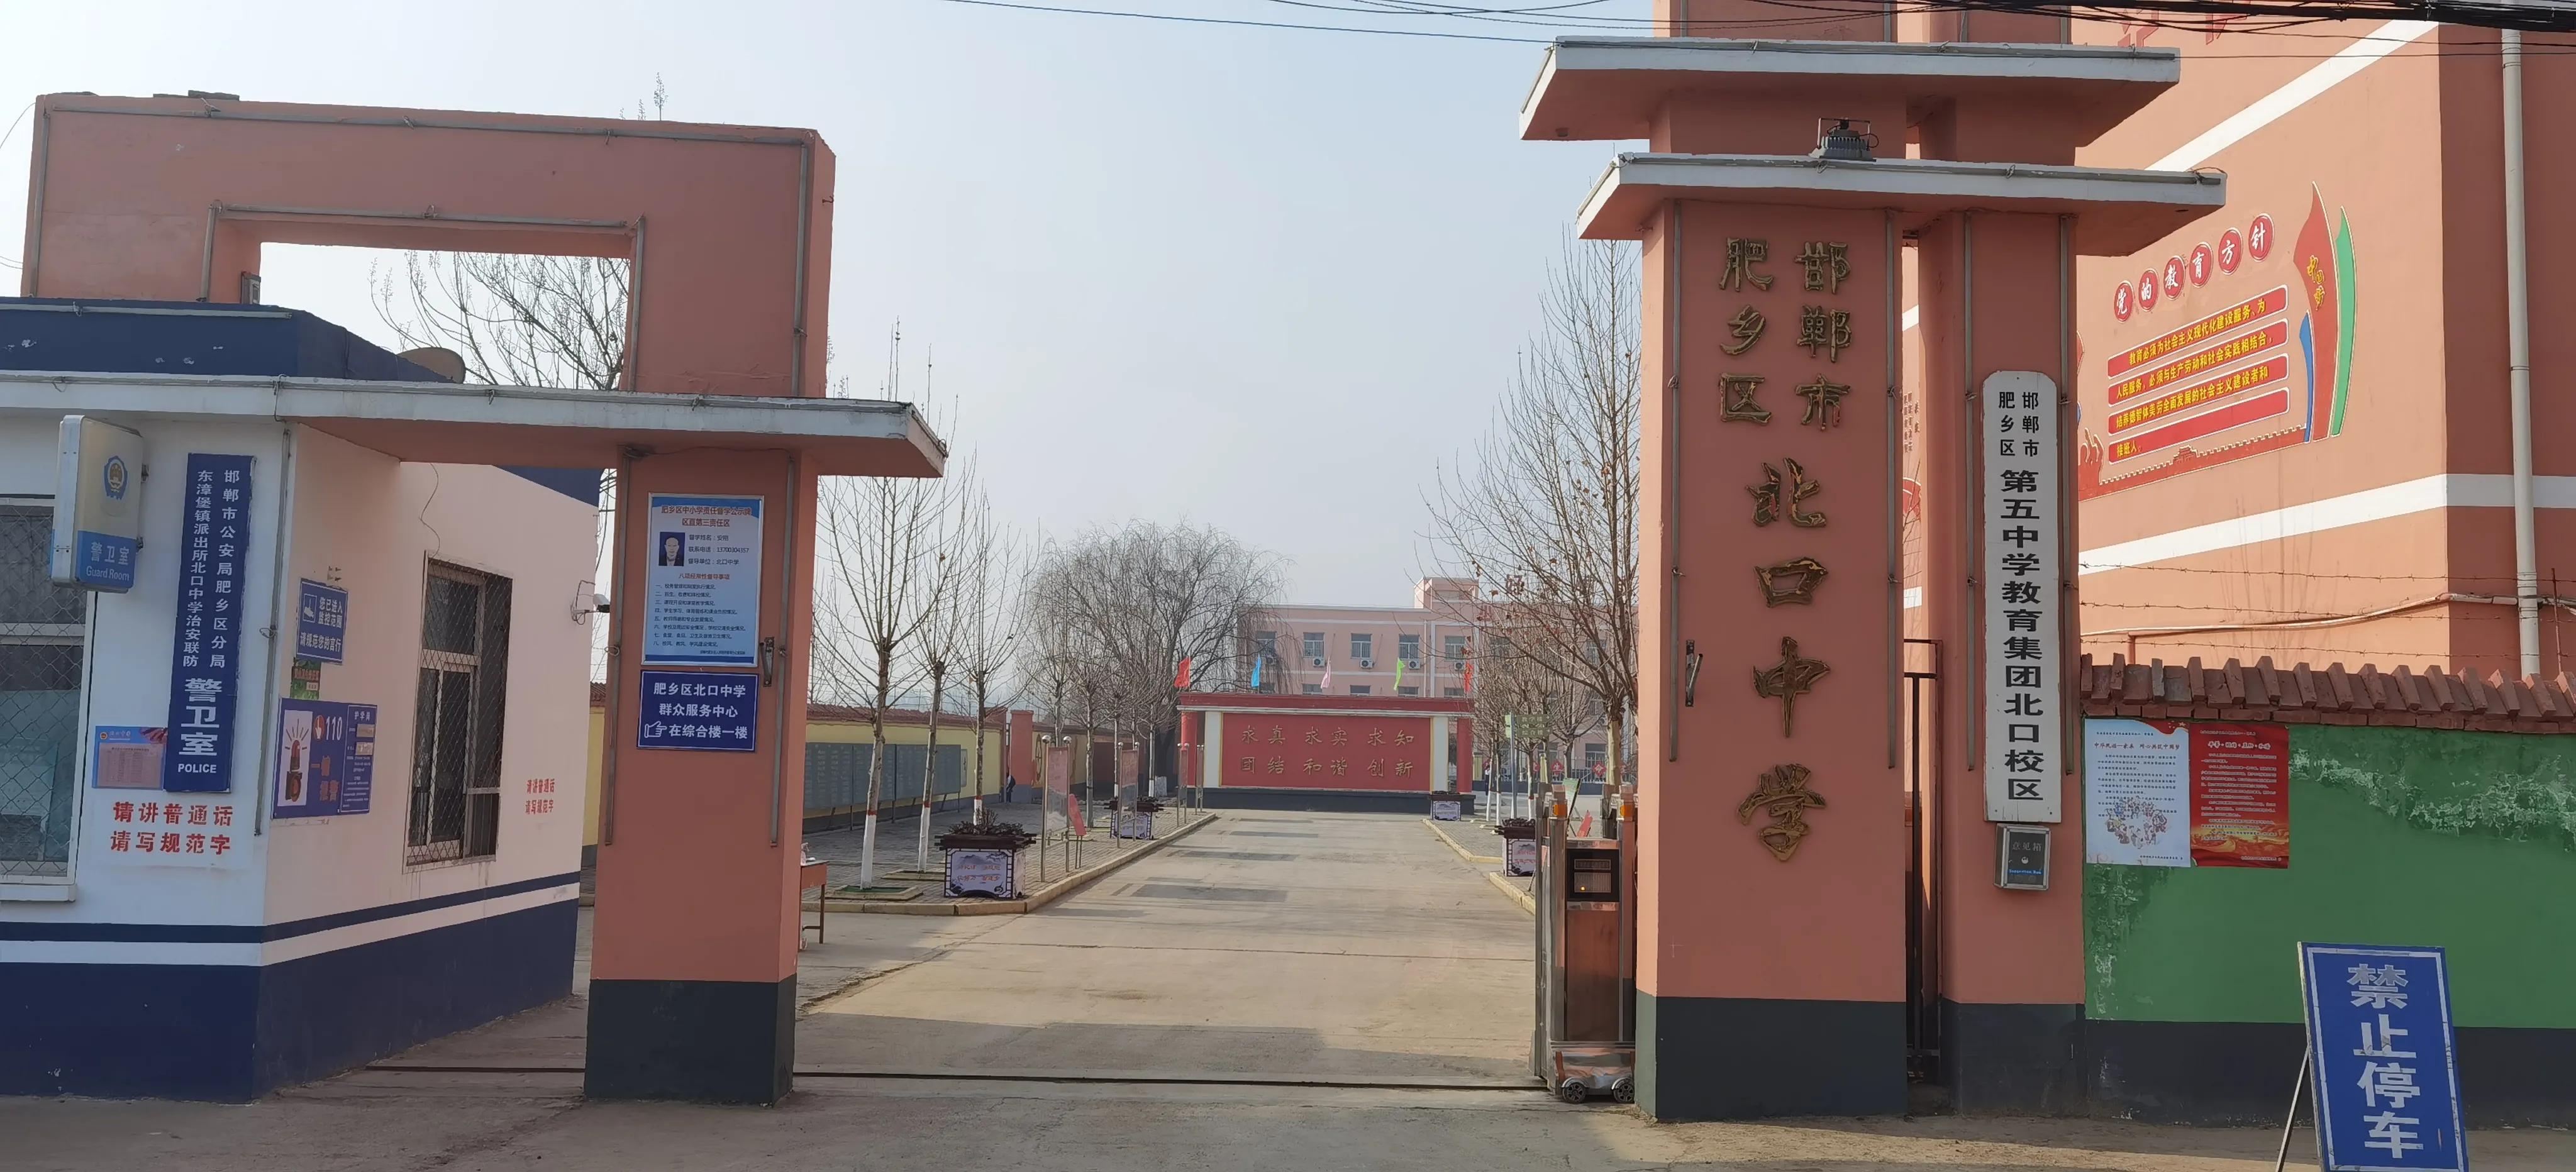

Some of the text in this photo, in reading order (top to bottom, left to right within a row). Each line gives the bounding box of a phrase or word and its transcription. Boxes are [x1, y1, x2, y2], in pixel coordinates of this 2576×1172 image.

[2116, 222, 2266, 316] 党的教育方针
[1718, 238, 1774, 426] 肥乡区
[1794, 241, 1852, 431] 邯郸市
[2116, 367, 2268, 429] 培养德智体美劳全面发展的社会主义建设者和
[1998, 392, 2015, 456] 肥乡区
[2022, 392, 2040, 458] 邯郸市
[91, 542, 130, 565] 警卫室
[86, 565, 129, 581] Guard Room
[183, 470, 214, 667] 东漳堡镇派出所北口中学治安联防
[209, 470, 240, 668] 邯郸市公安局肥乡区分局
[319, 597, 343, 614] 您已进入
[318, 611, 343, 628] 监控范围
[2001, 470, 2043, 800] 第五中学教育集团北口校区
[1738, 457, 1831, 861] 北口中学
[653, 682, 746, 697] 肥乡区北口中学
[179, 678, 223, 756] 警卫室
[658, 703, 738, 717] 群众服务中心
[326, 716, 342, 740] 110
[669, 724, 748, 739] 在综合楼一楼
[1241, 724, 1414, 747] 求真 求实 求知
[177, 763, 217, 773] POLICE
[1241, 756, 1413, 778] 团结 和谐 创新
[113, 801, 233, 826] 请讲普通话
[111, 830, 231, 855] 请写规范字
[2346, 963, 2424, 1158] 禁止停车
